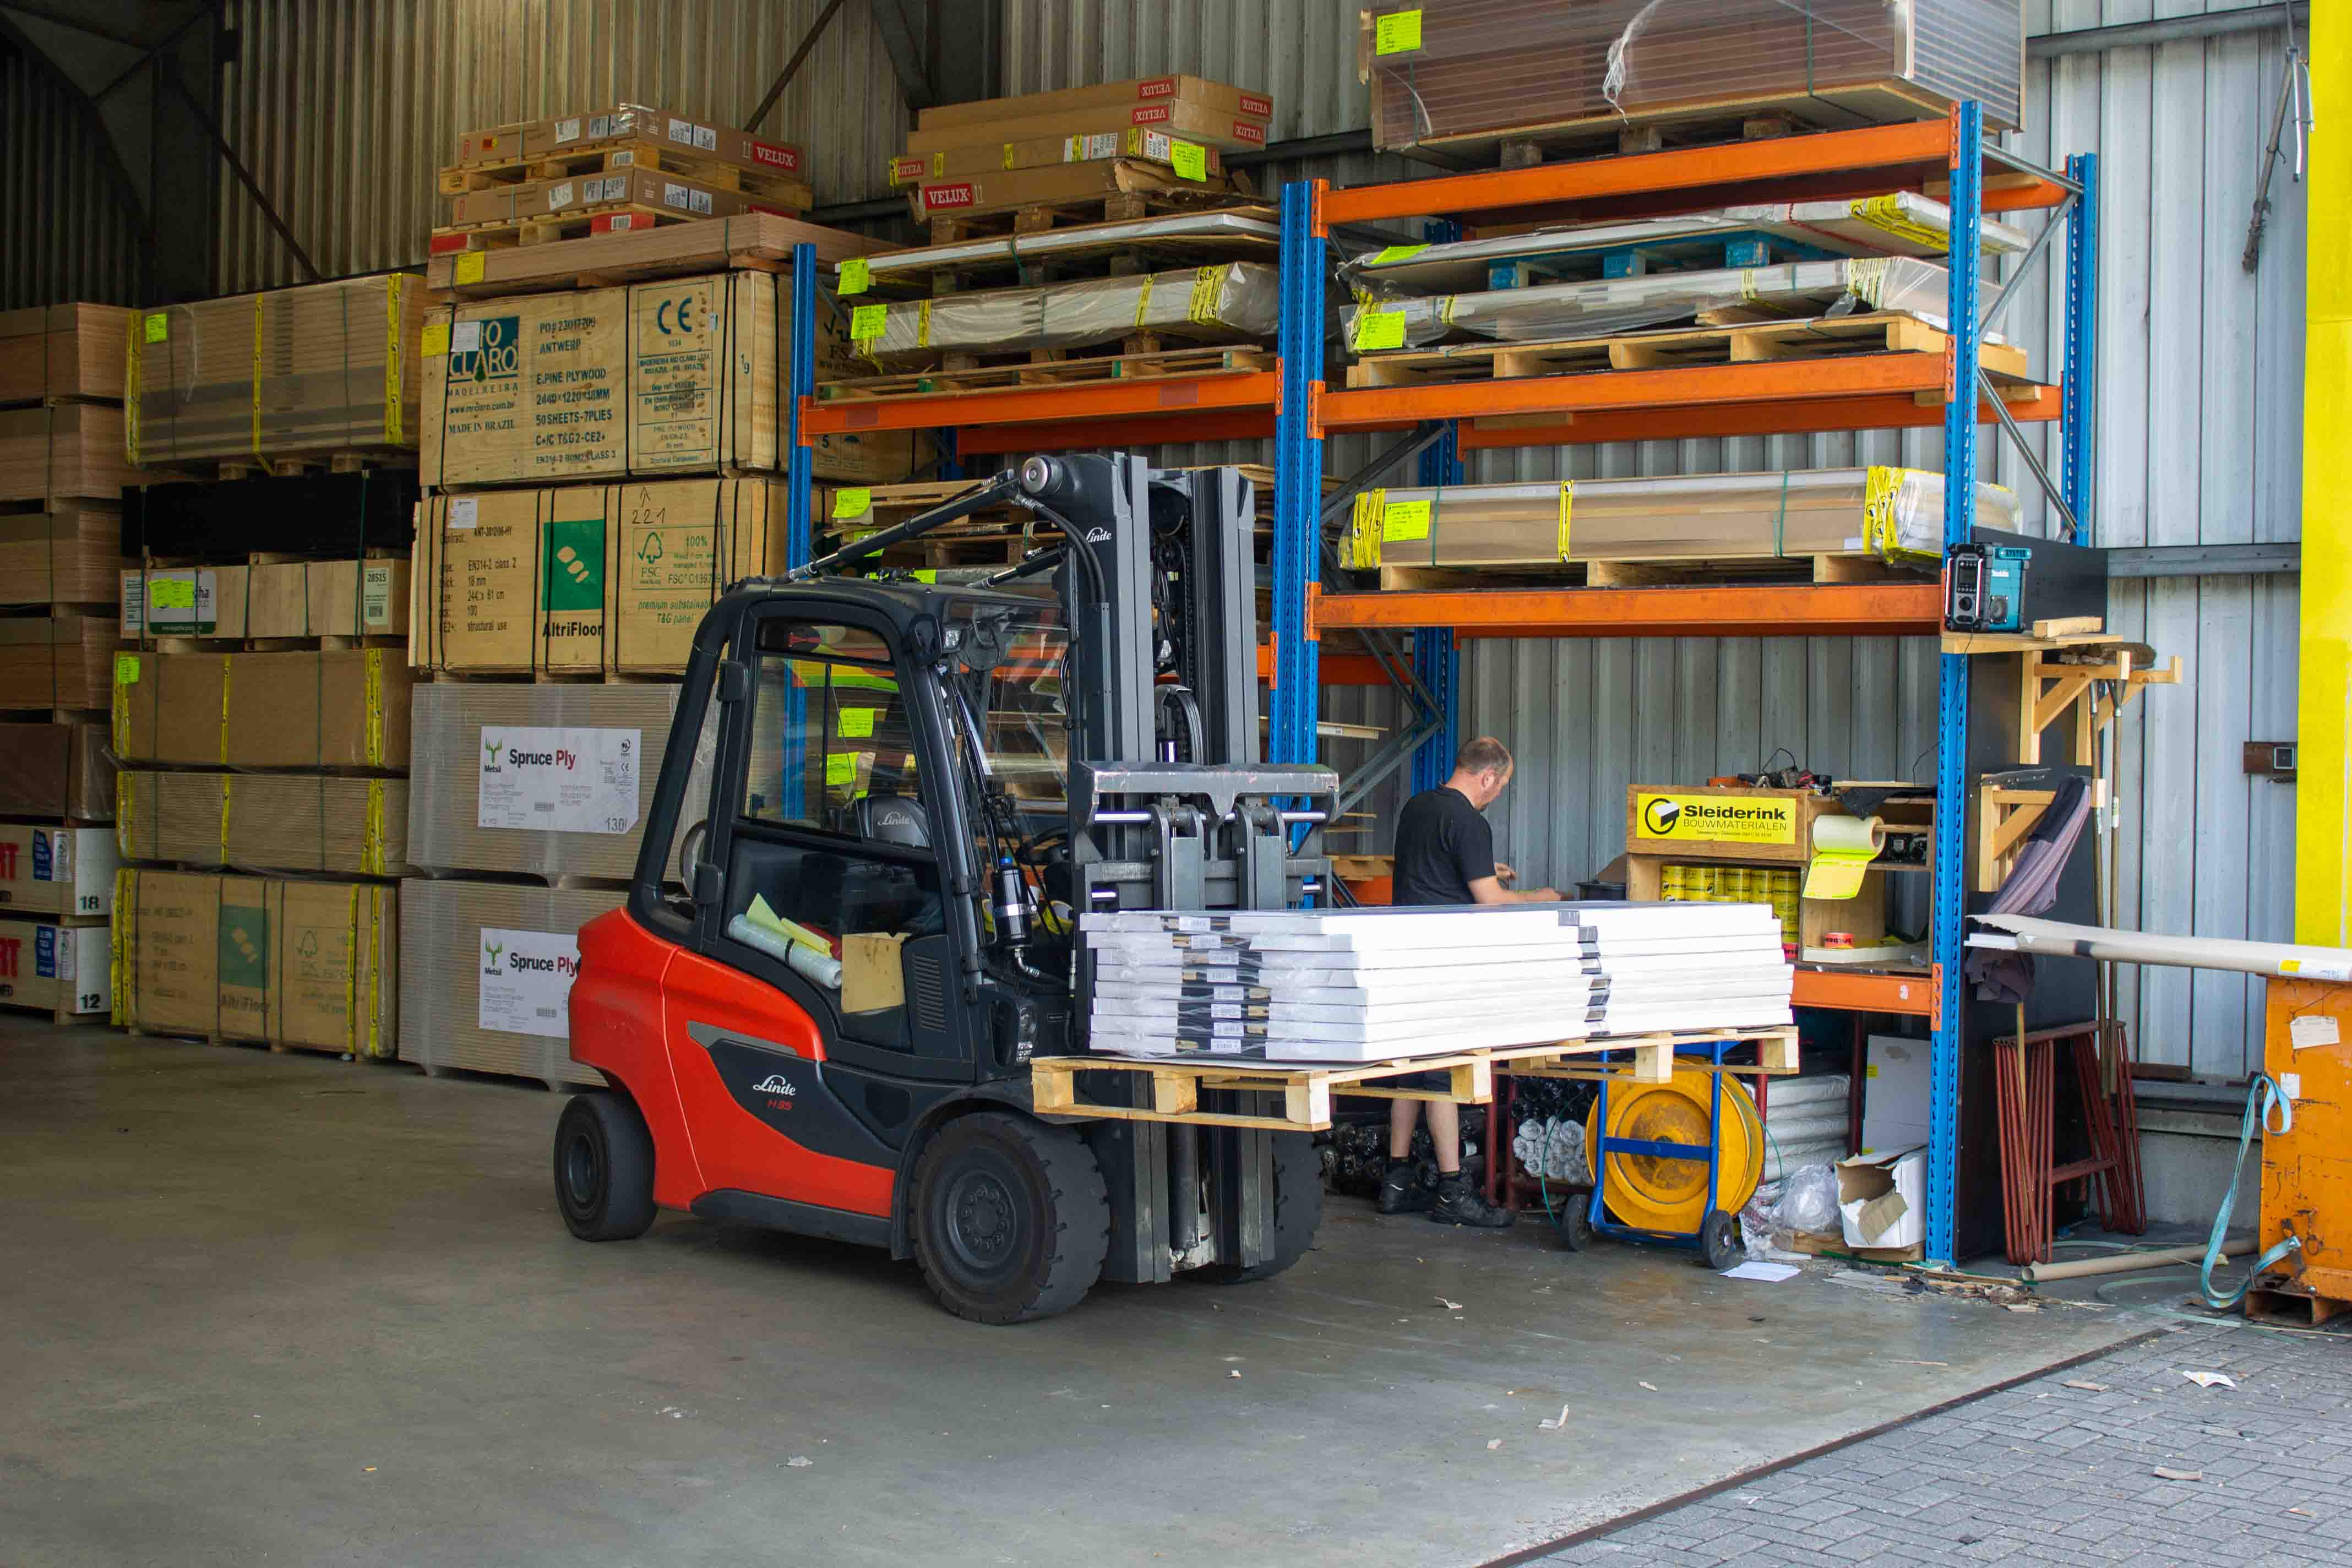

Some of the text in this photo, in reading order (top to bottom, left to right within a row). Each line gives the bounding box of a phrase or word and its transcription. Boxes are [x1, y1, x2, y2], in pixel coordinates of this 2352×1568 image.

[1142, 84, 1172, 96] VELUX
[1242, 99, 1268, 114] VELUX
[1136, 109, 1166, 121] VELUX
[1235, 126, 1262, 140] VELUX
[757, 146, 794, 167] VELUX
[928, 188, 969, 204] VELUX
[540, 339, 581, 354] ANTWERP
[449, 346, 517, 380] CLARO
[566, 368, 606, 382] PLYWOOD
[448, 383, 519, 398] MADEIREIRA
[449, 419, 515, 434] MADE IN BRAZIL
[685, 535, 707, 547] 100%
[1086, 527, 1112, 542] Linde
[468, 558, 492, 571] EN314-2
[494, 557, 509, 569] class
[511, 556, 517, 568] 2
[367, 573, 386, 582] 28515
[641, 567, 661, 578] FSC
[468, 575, 475, 586] 18
[497, 620, 507, 630] use
[543, 622, 605, 637] AltriFloor
[509, 748, 576, 770] Spruce Ply
[484, 765, 502, 773] Metsä
[878, 811, 910, 825] Linde
[1685, 805, 1786, 820] Sleiderink
[1684, 819, 1787, 831] BOUWMATERIALEN
[80, 895, 100, 911] 18
[484, 967, 502, 976] Metsä
[510, 952, 576, 977] Spruce Ply
[80, 993, 100, 1009] 12
[753, 1075, 796, 1096] Linde
